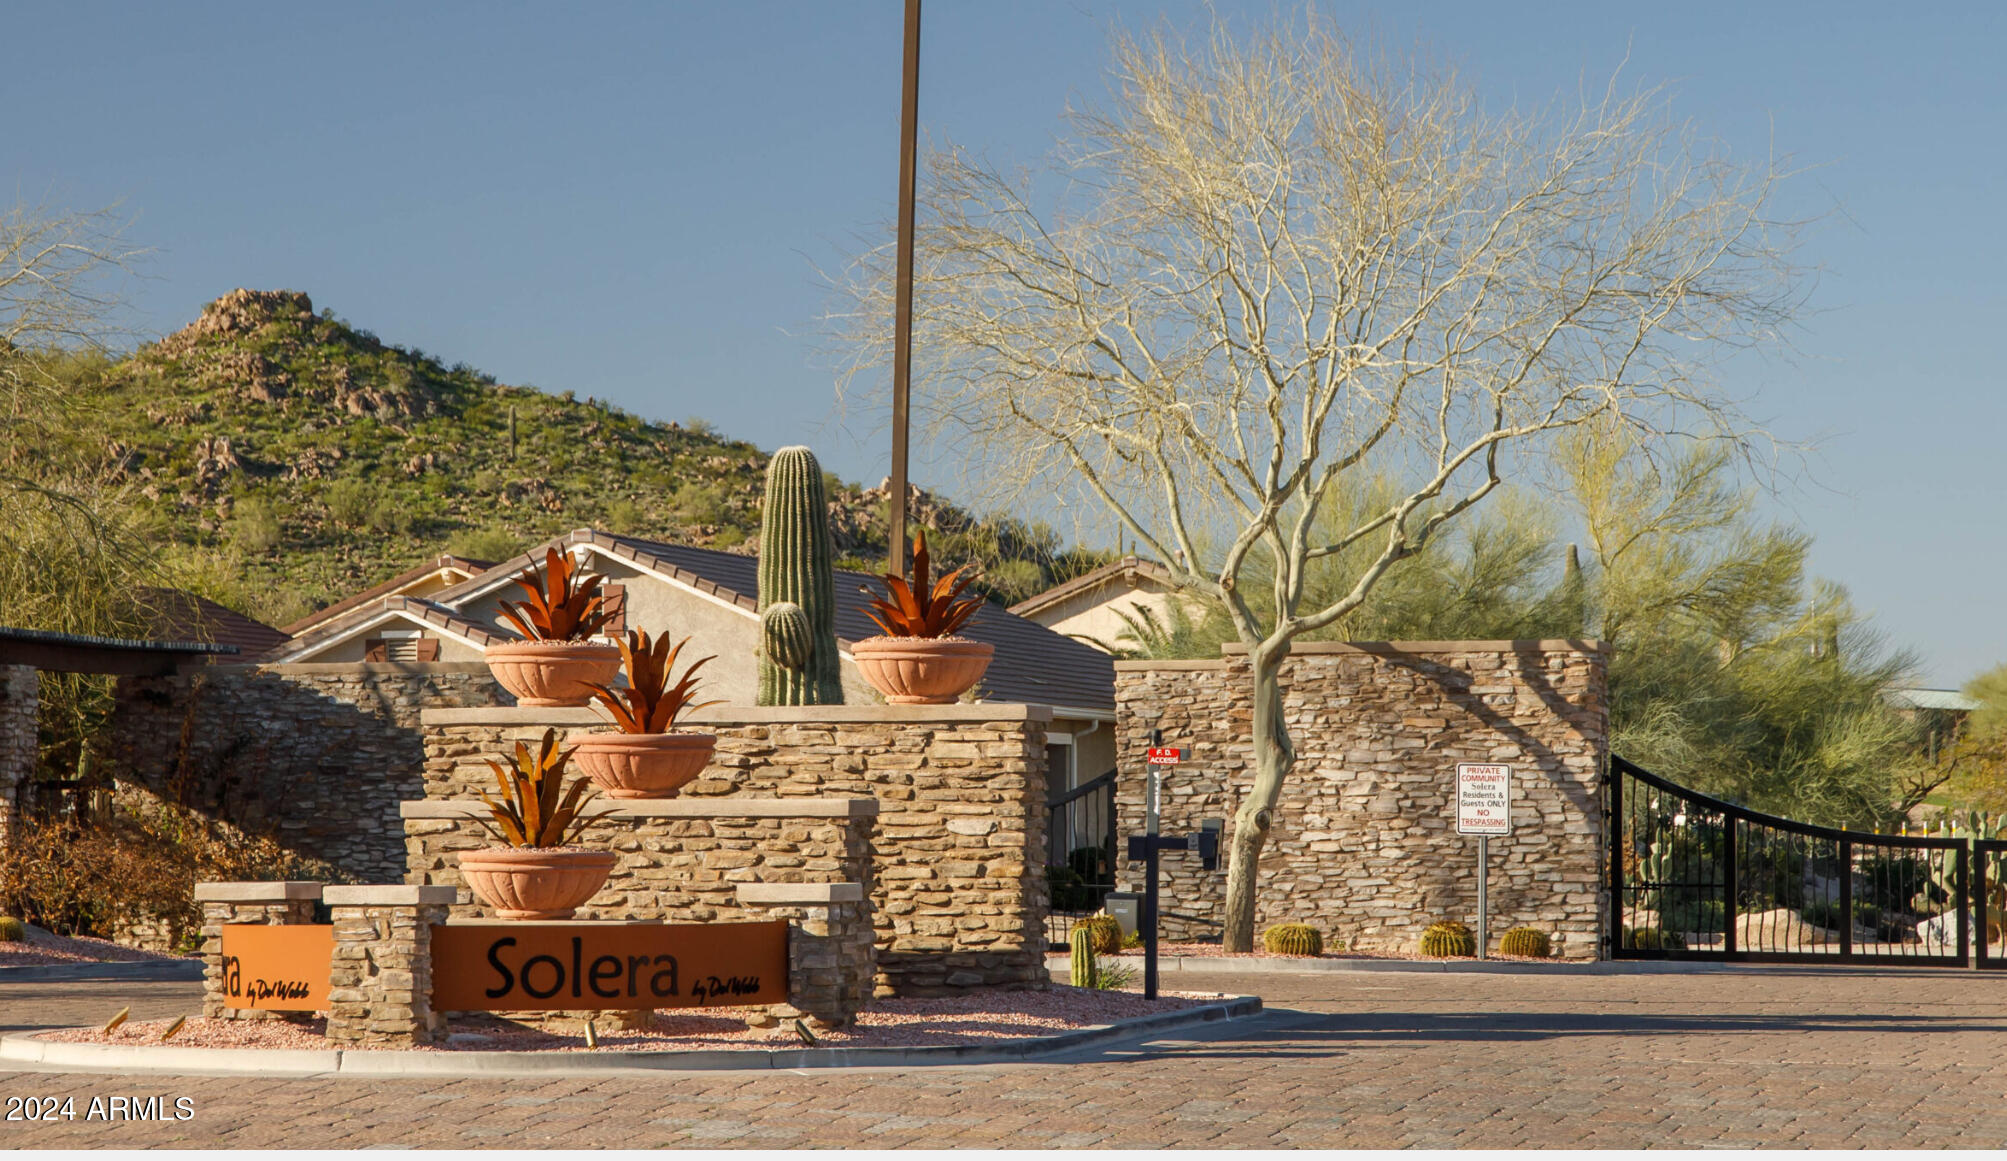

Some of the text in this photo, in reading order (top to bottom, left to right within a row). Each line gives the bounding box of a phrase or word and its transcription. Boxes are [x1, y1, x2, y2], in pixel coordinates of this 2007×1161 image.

[1487, 800, 1506, 808] ONLY
[1461, 818, 1506, 826] TRESPASSING
[222, 956, 241, 997] ra
[246, 982, 256, 1007] by
[485, 936, 679, 999] Solera
[691, 979, 707, 1005] by
